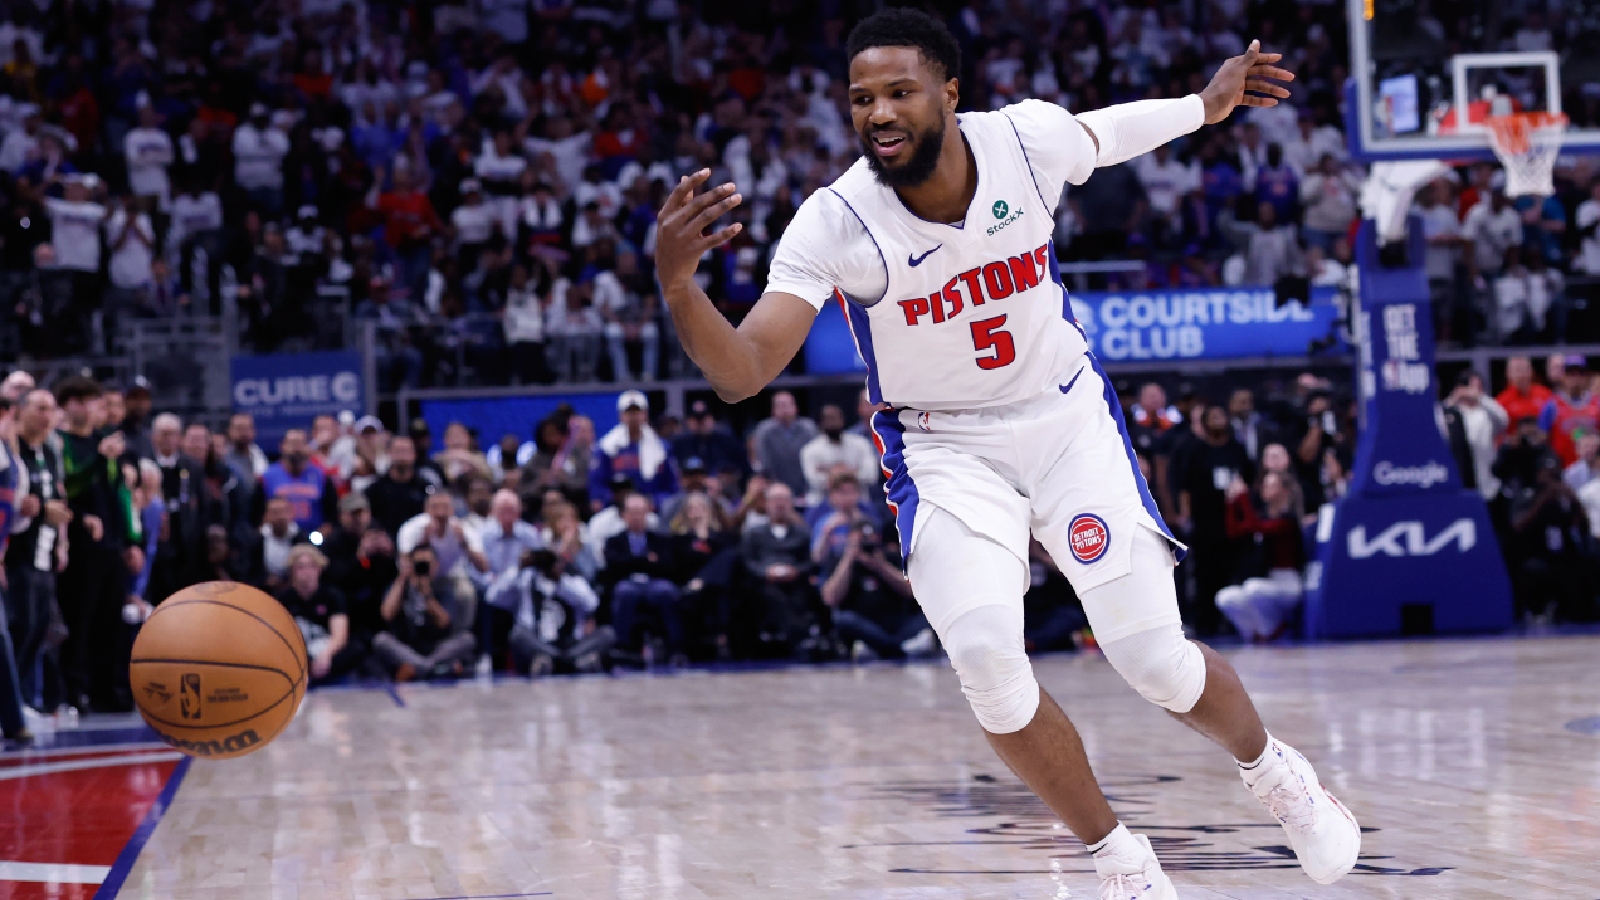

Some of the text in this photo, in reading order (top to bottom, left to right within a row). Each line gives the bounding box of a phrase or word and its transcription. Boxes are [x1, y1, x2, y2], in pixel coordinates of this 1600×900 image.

[897, 243, 1048, 327] PISTONS
[970, 313, 1016, 370] 5
[1102, 326, 1205, 360] CLUB
[234, 375, 328, 406] CURE
[1374, 459, 1449, 488] Google
[1073, 527, 1099, 543] DETROIT
[1347, 518, 1476, 559] KIA
